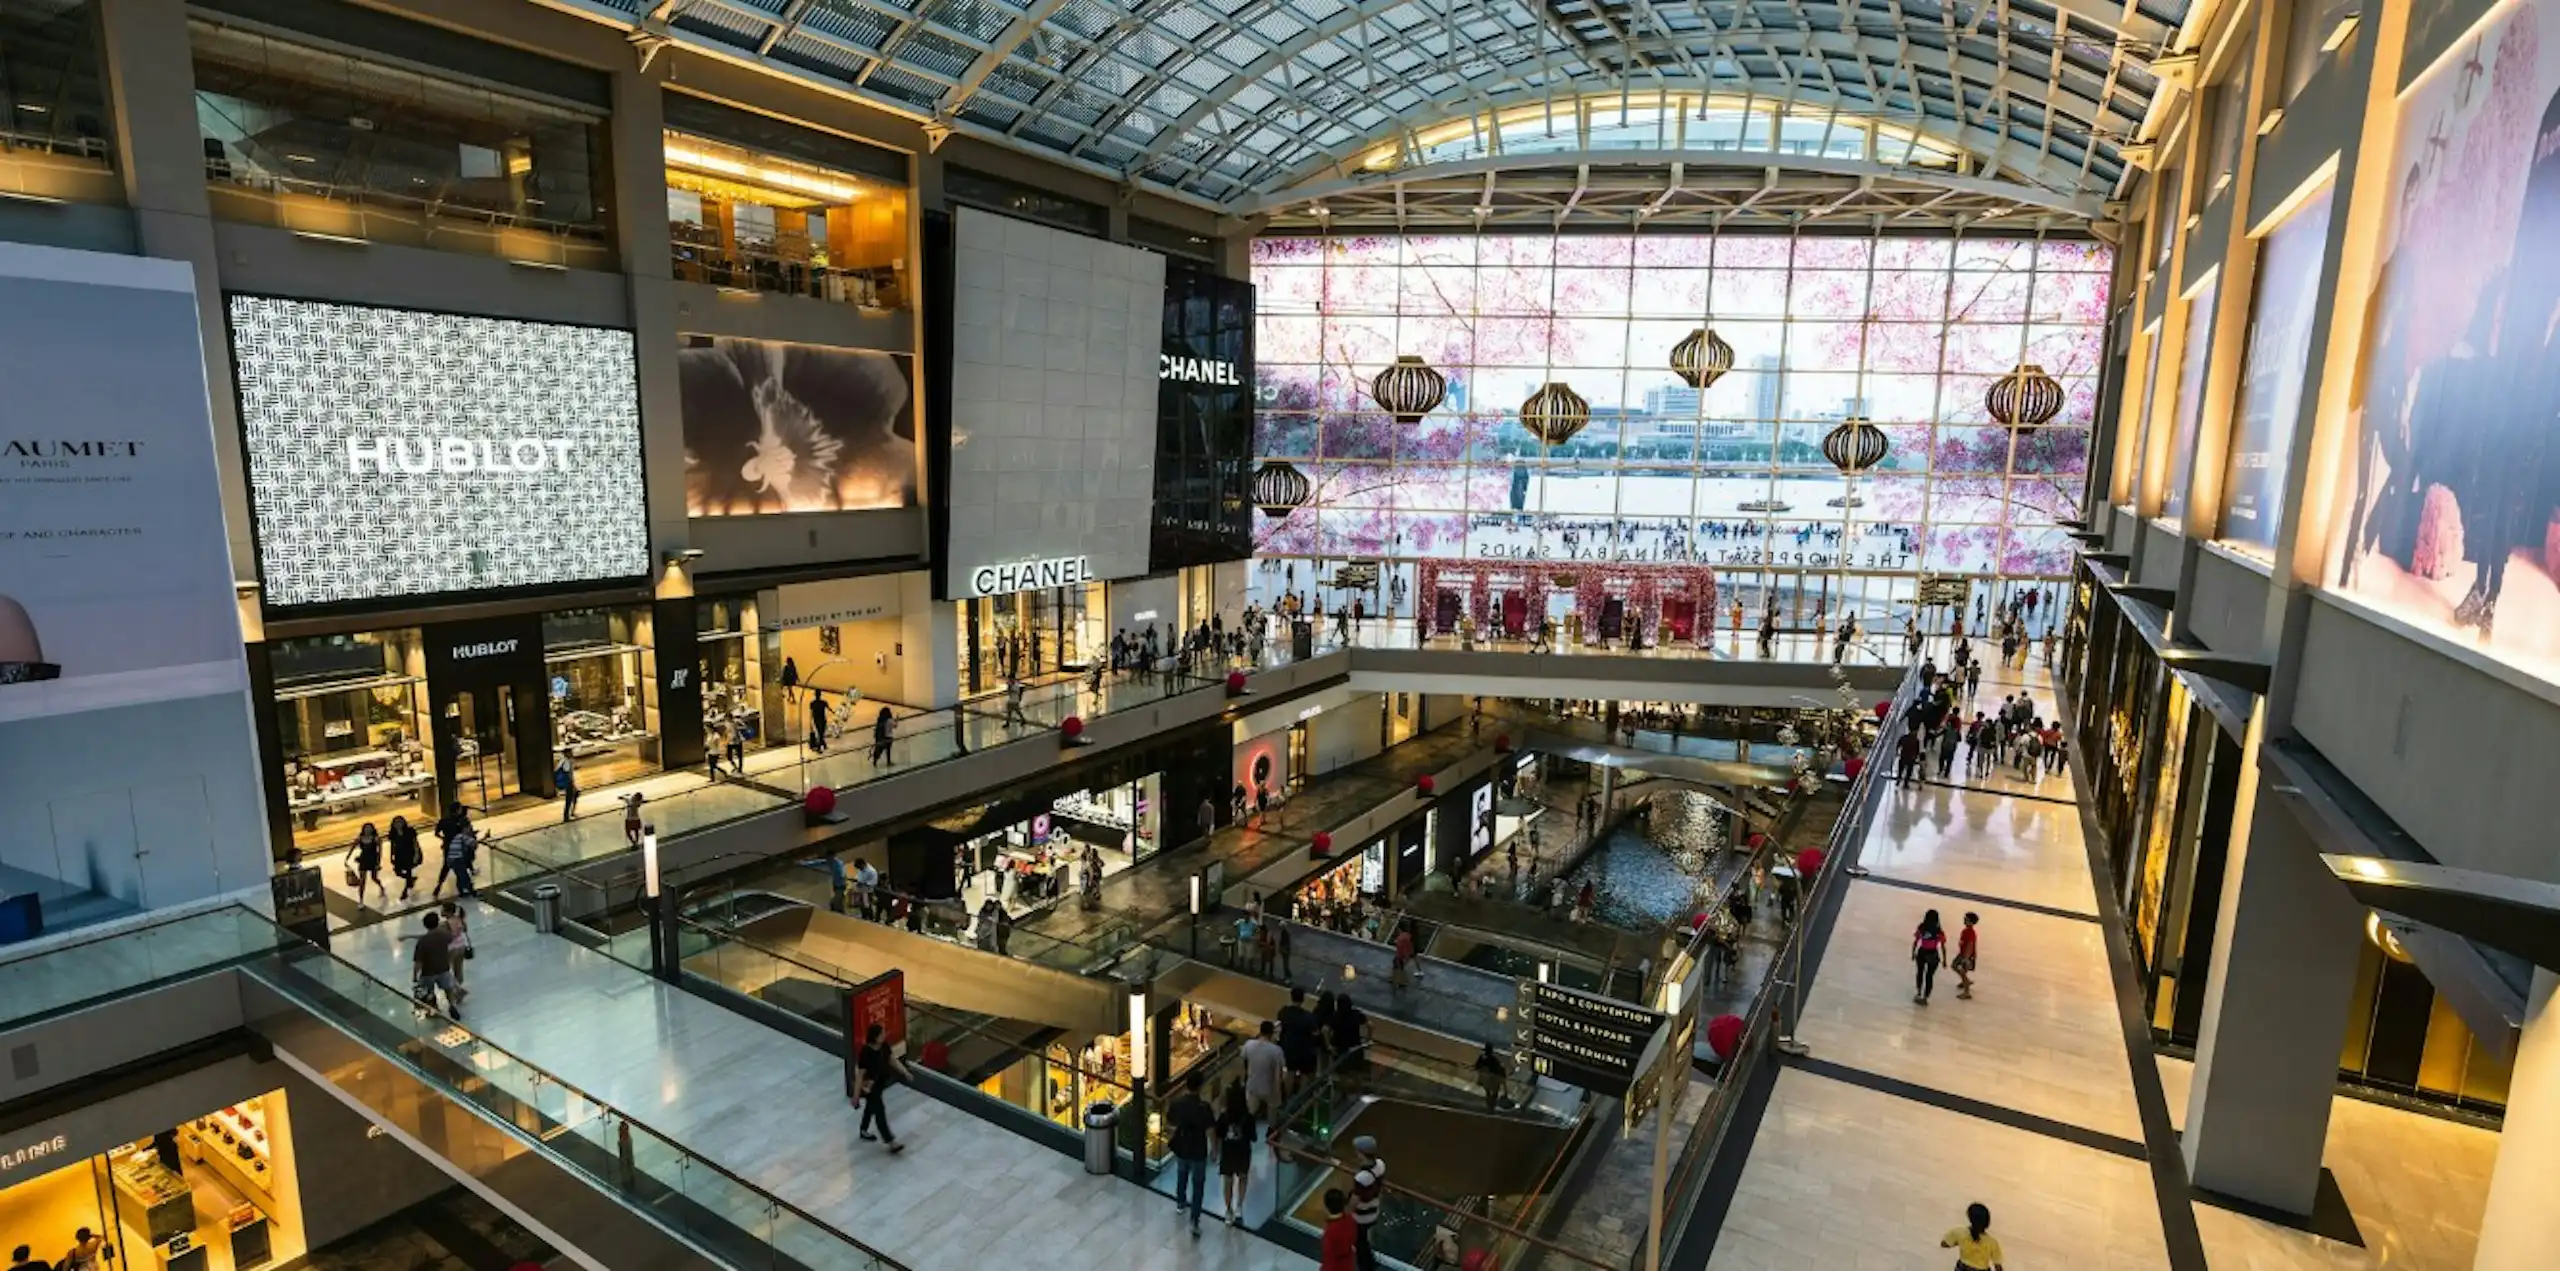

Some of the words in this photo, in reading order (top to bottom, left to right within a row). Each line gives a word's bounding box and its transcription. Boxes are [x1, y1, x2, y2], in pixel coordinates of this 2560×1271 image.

[1159, 353, 1240, 386] CHANEL
[348, 437, 574, 473] HUBLOT
[23, 530, 54, 539] AND
[58, 527, 143, 538] CHARACTER
[973, 555, 1094, 597] CHANEL
[453, 639, 519, 659] HUBLOT
[1539, 987, 1567, 1003] EXPO
[1578, 999, 1653, 1025] CONVENTION
[1538, 1010, 1571, 1029] HOTEL
[1583, 1023, 1633, 1044] SKYPARK
[1536, 1033, 1572, 1052] COACH
[1573, 1044, 1629, 1068] TERMINAL
